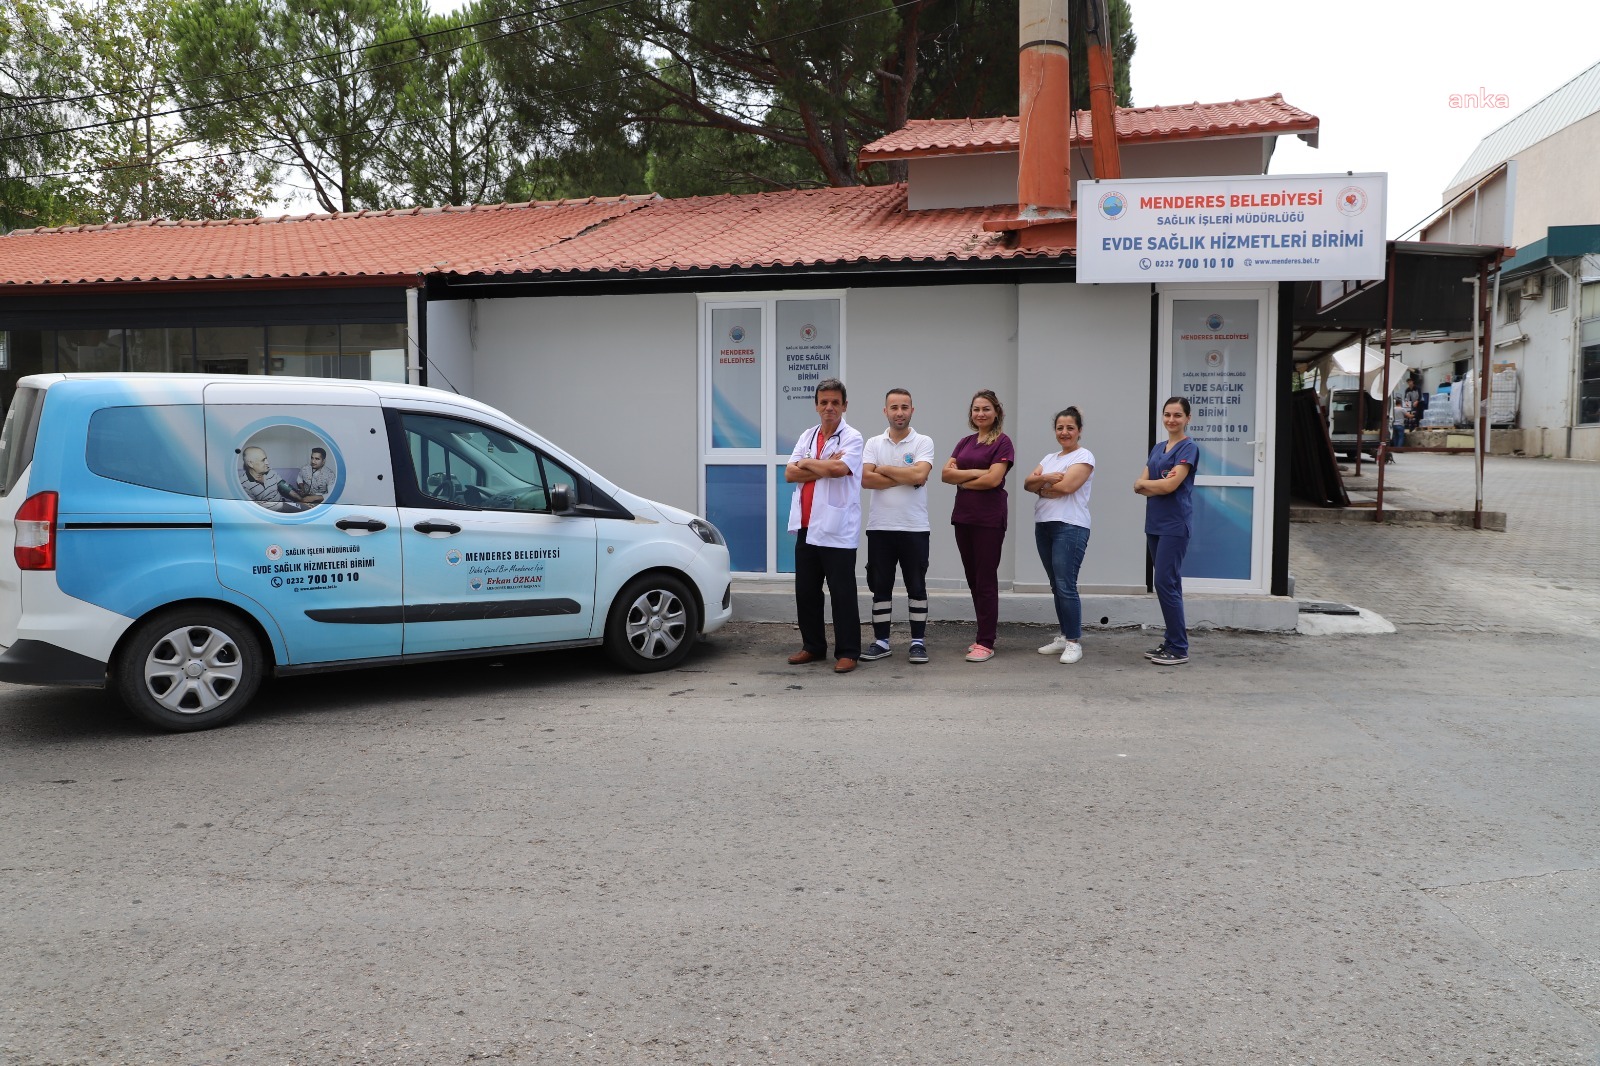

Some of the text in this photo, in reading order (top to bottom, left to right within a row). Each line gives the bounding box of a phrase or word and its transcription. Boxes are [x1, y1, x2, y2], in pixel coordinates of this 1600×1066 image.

[1140, 195, 1226, 209] MENDERES
[1230, 189, 1322, 208] BELEDİYESİ
[1157, 211, 1305, 226] SAĞLIK İŞLERİ MÜDÜRLÜĞÜ
[1102, 229, 1364, 251] EVDE SAĞLIK HİZMETLERİ BİRİMİ
[1155, 257, 1235, 269] 0232 700 10 10
[1254, 257, 1320, 265] www.menderes.bel.tr
[805, 353, 831, 361] SAĞLIK
[788, 362, 829, 371] HİZMETLERİ
[797, 372, 819, 380] BİRİMİ
[1183, 381, 1244, 391] EVDE SAĞLIK
[1187, 394, 1241, 404] HİZMETLERİ
[1198, 406, 1228, 417] BİRİMİ
[1206, 424, 1223, 433] 700
[1225, 424, 1235, 433] 10
[1238, 424, 1248, 433] 10
[285, 547, 306, 557] SAĞLIK
[307, 546, 325, 557] İŞLERİ
[326, 544, 360, 554] MÜDÜRLÜĞÜ
[466, 551, 512, 562] MENDERES
[514, 548, 560, 560] BELEDİYESİ
[252, 556, 375, 575] EVDE SAĞLIK HİZMETLERİ BİRİMİ
[286, 571, 359, 585] 0232 700 10 10
[486, 577, 511, 585] Erkan
[512, 575, 542, 584] ÖZKAN
